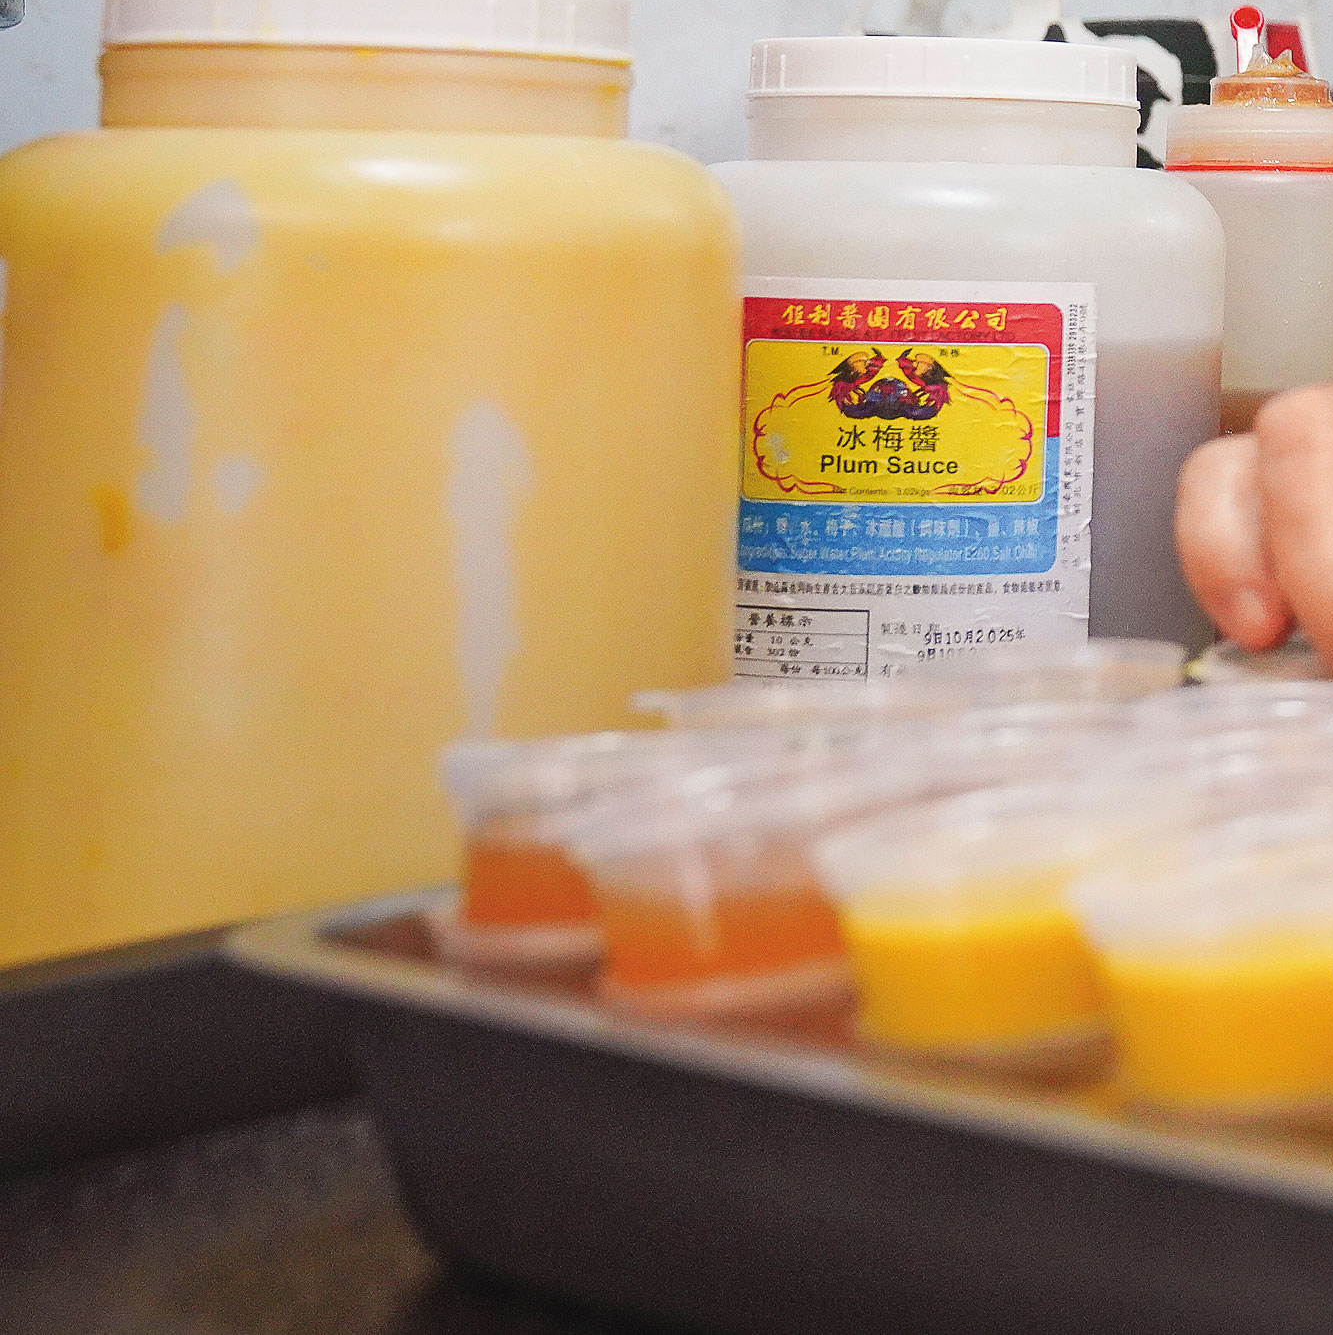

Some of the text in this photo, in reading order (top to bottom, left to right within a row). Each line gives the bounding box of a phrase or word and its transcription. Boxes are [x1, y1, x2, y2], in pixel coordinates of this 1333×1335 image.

[836, 424, 941, 452] 冰梅醬
[820, 454, 959, 475] Plum Sauce
